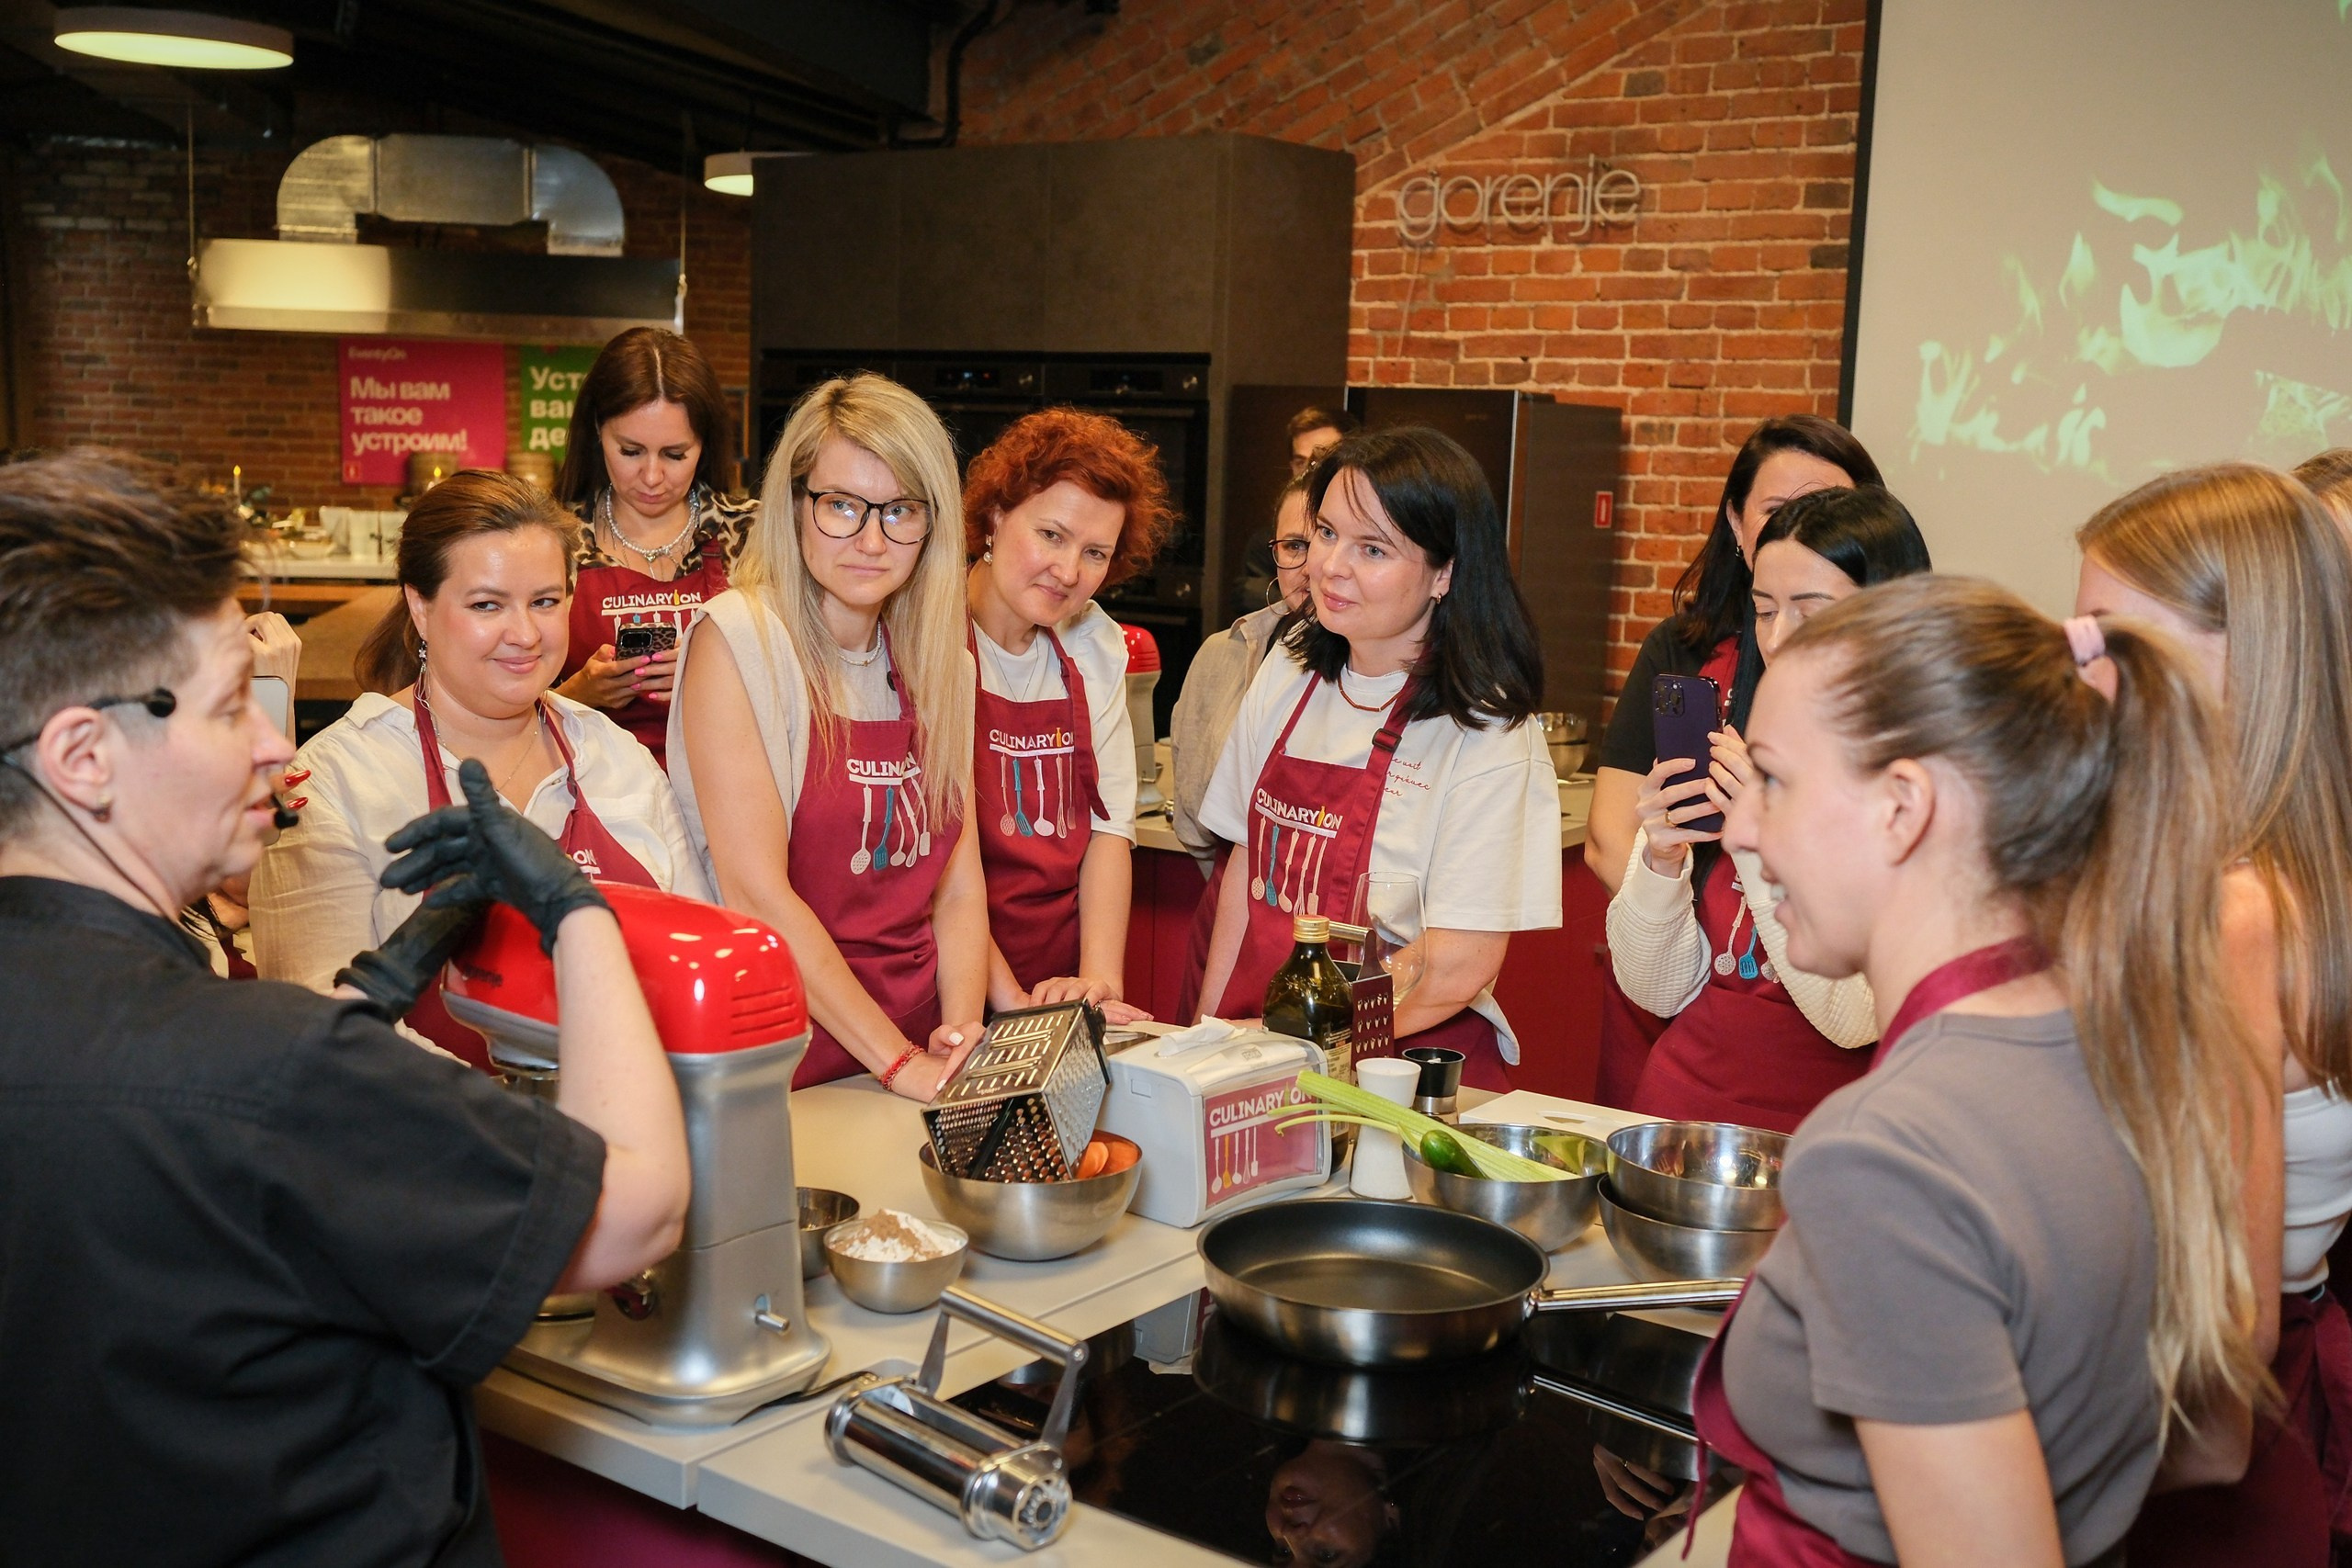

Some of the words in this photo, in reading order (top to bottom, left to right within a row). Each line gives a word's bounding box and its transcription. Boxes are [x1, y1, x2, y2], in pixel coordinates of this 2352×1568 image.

[1397, 152, 1642, 241] gorenje
[349, 376, 396, 400] Мы
[399, 381, 451, 400] вам
[530, 366, 587, 390] Уст
[349, 406, 424, 426] такое
[350, 427, 468, 457] устроим!
[602, 592, 673, 609] CULINARY
[680, 592, 702, 604] ON
[989, 728, 1056, 750] CULINARY
[1256, 787, 1320, 825] CULINARY
[1323, 812, 1344, 830] ON
[1209, 1089, 1284, 1127] CULINARY
